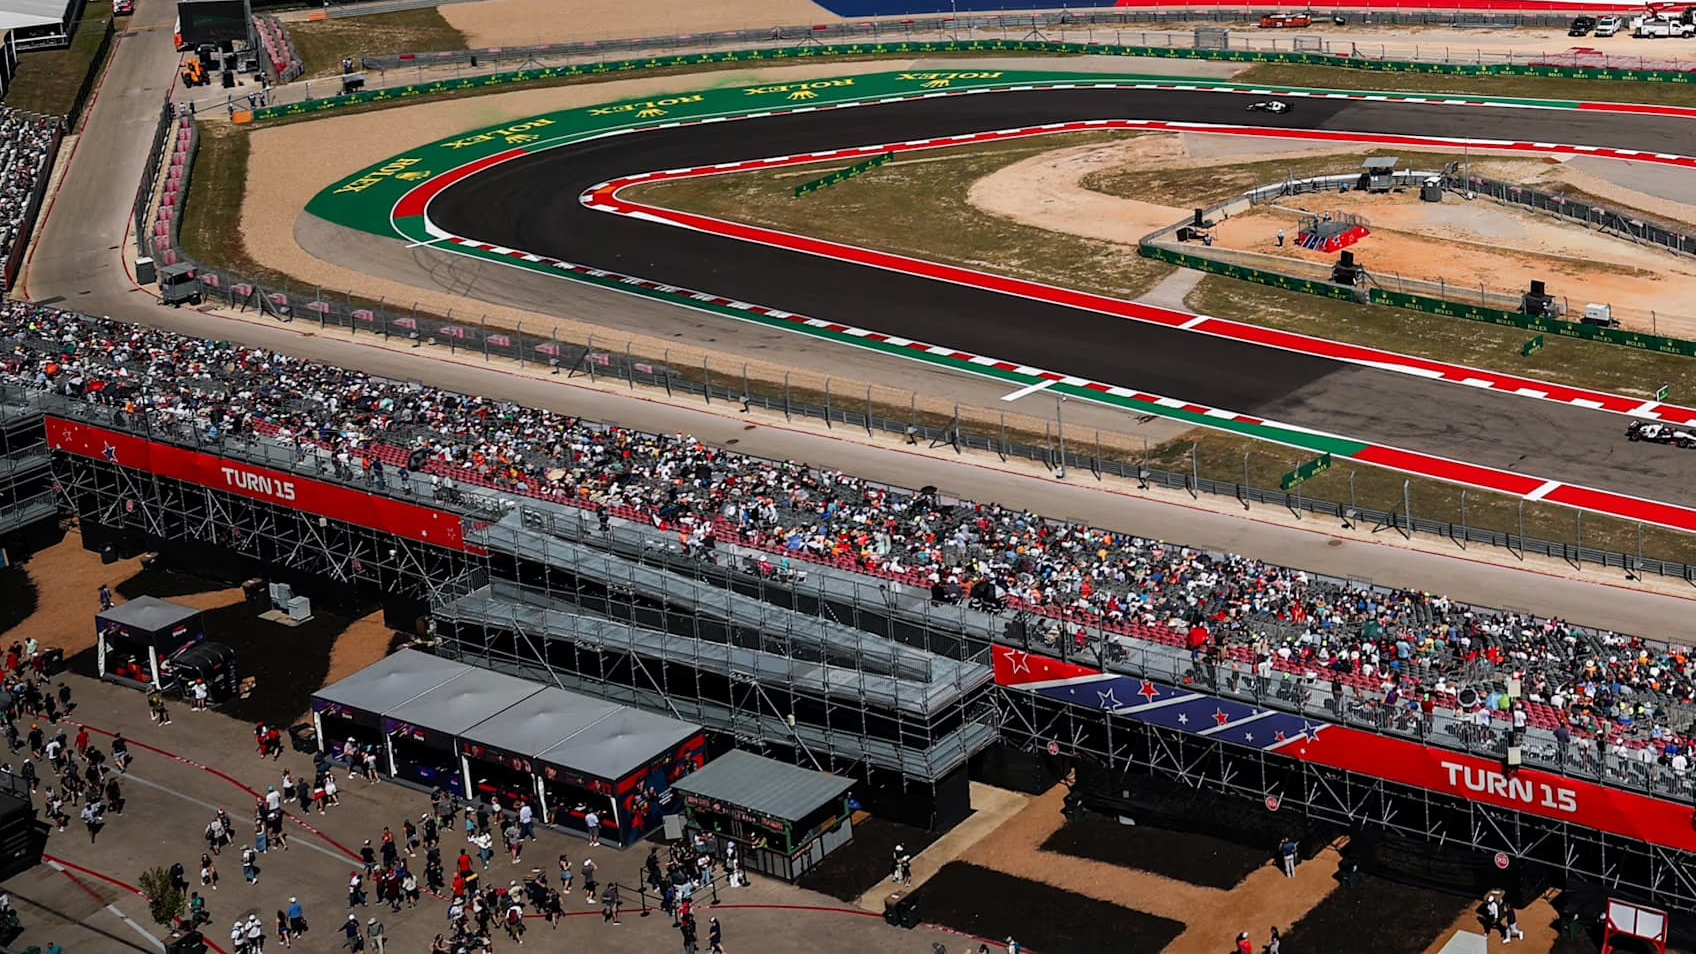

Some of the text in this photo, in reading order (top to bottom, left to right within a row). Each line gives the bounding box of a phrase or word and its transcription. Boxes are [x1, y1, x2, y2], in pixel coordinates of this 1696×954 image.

[744, 78, 855, 95] ROLEX
[588, 95, 704, 117] ROLEX
[440, 118, 555, 149] ROLEX
[333, 156, 422, 194] ROLEX
[1659, 344, 1680, 353] ROLEX
[222, 467, 295, 500] TURN 15
[1441, 761, 1576, 812] TURN 15
